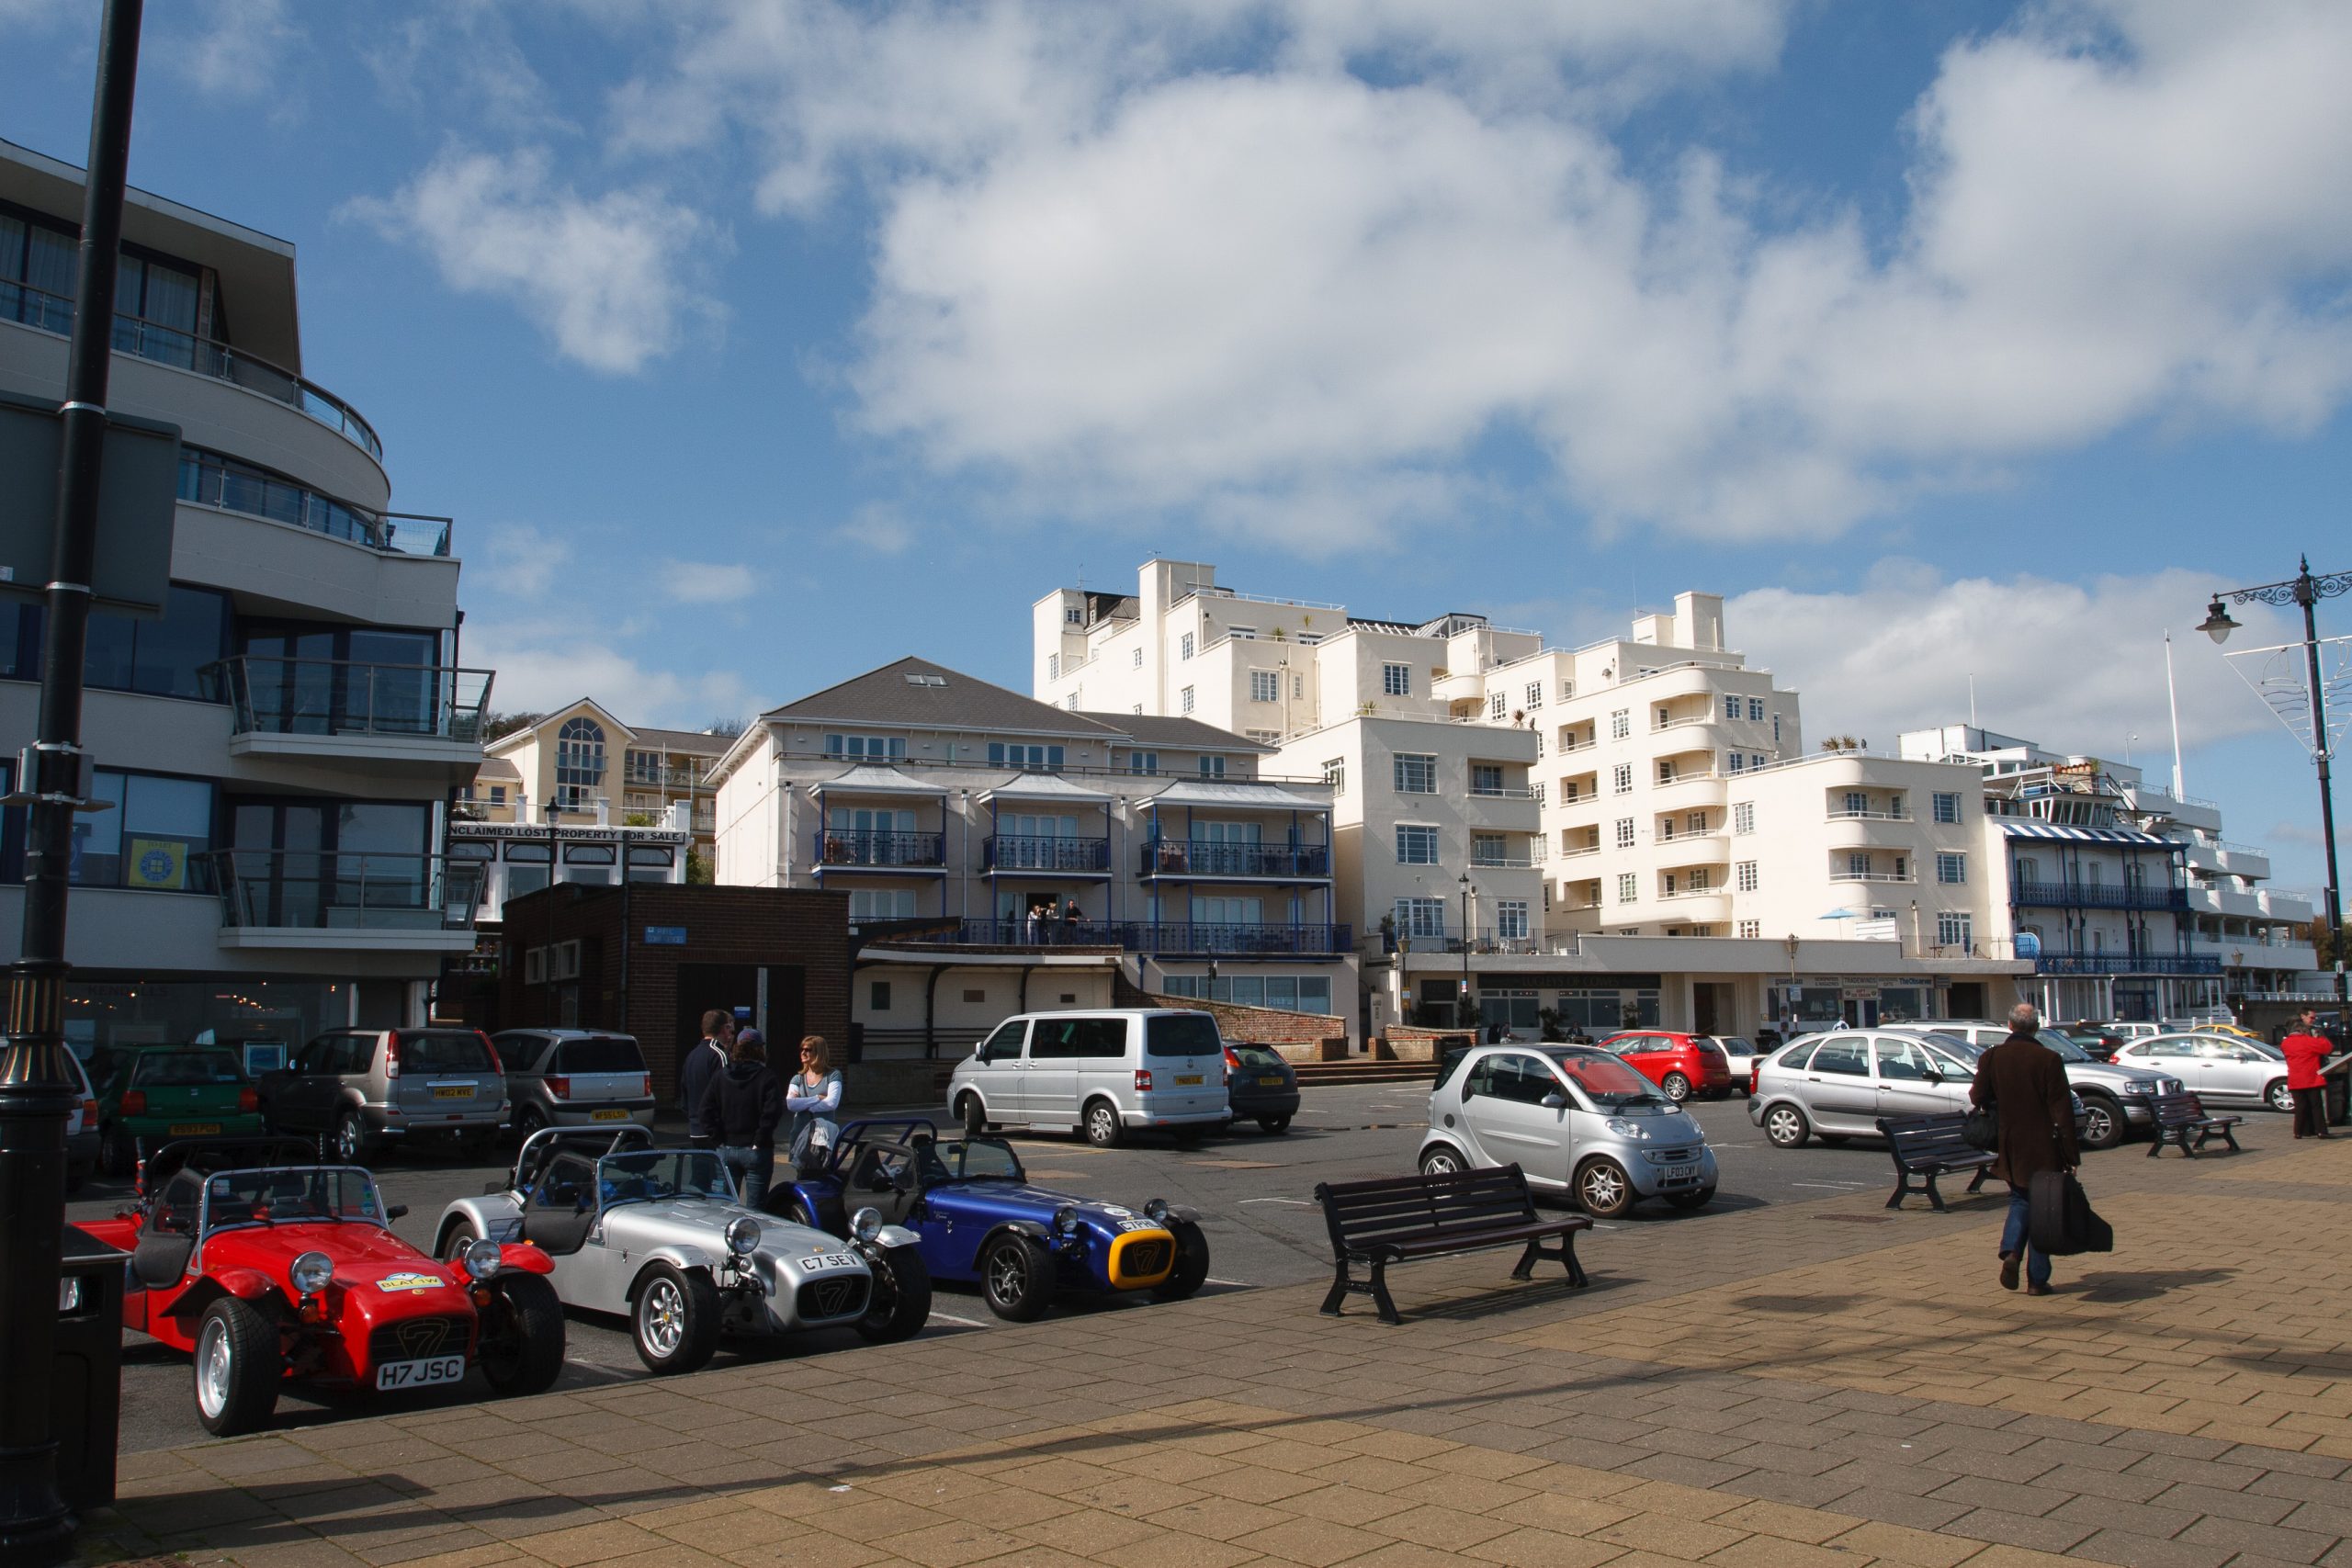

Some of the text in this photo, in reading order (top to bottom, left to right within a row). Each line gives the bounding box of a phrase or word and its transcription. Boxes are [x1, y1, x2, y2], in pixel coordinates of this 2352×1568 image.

[448, 826, 680, 840] NCLAIMED LOST PROPERTY OR SALE
[802, 1255, 857, 1270] C7 SEV
[381, 1359, 460, 1386] H7 JSC
